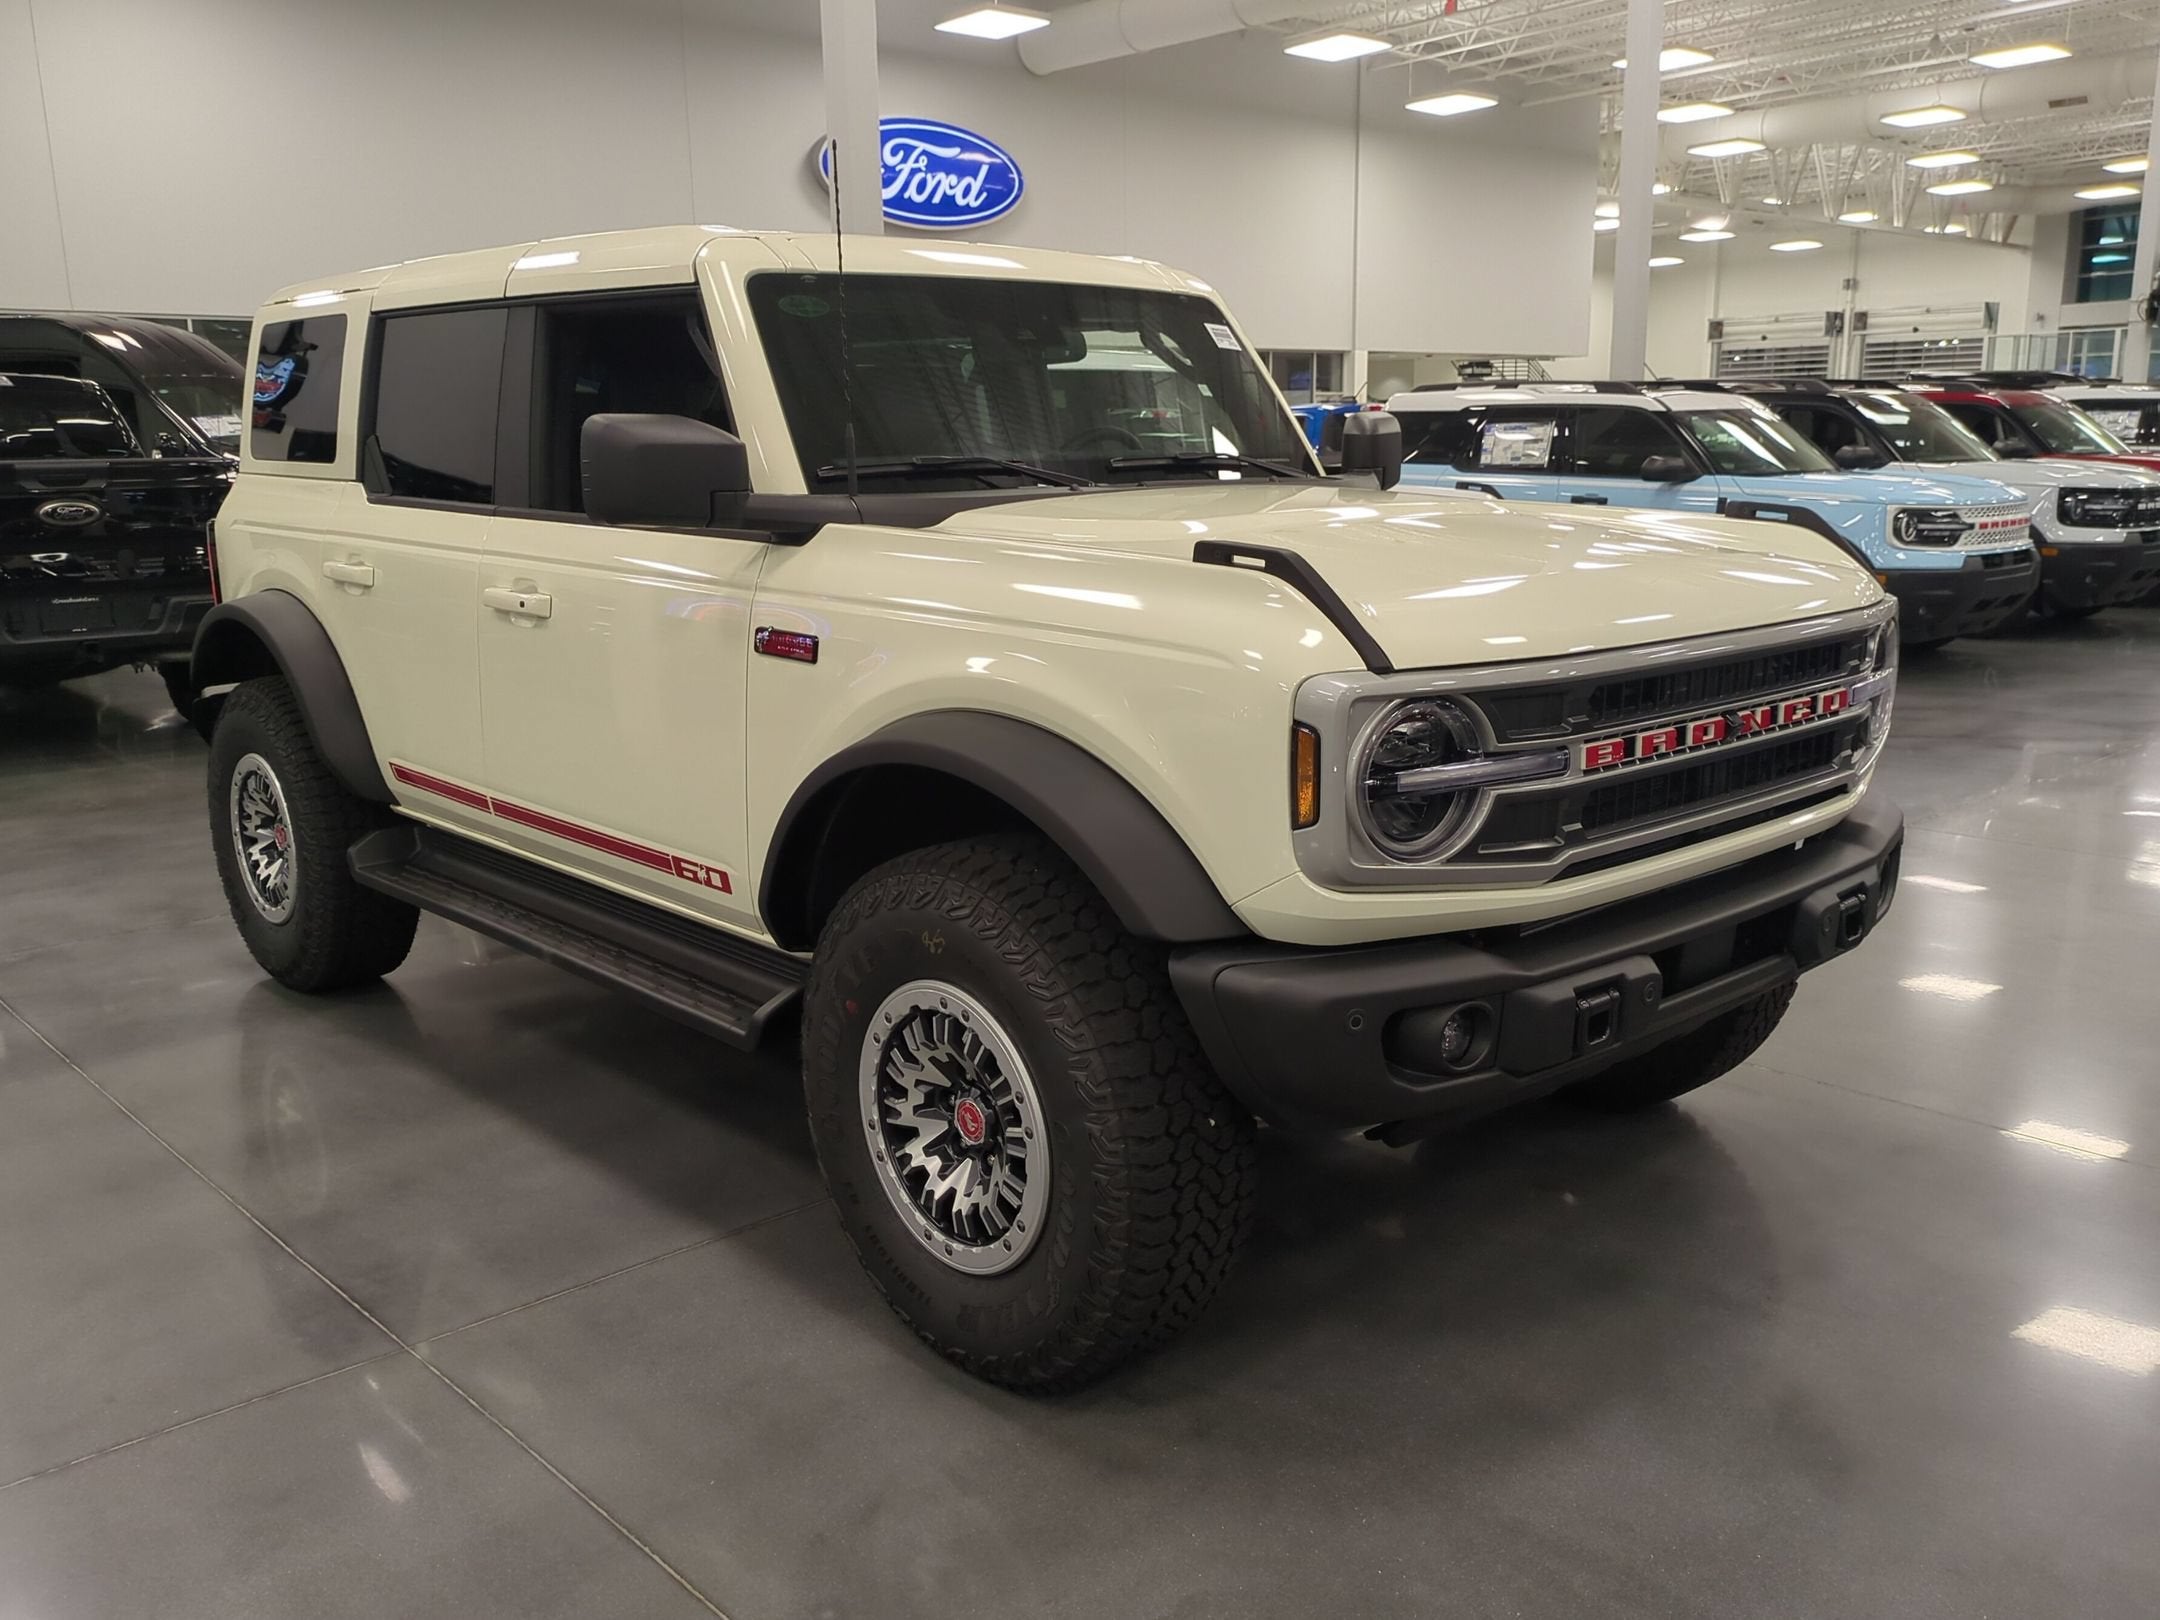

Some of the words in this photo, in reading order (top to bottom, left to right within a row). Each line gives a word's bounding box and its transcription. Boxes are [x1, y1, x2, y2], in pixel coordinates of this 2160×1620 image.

[882, 137, 990, 208] Ford
[1580, 687, 1850, 770] BRONCO
[671, 854, 733, 895] 60
